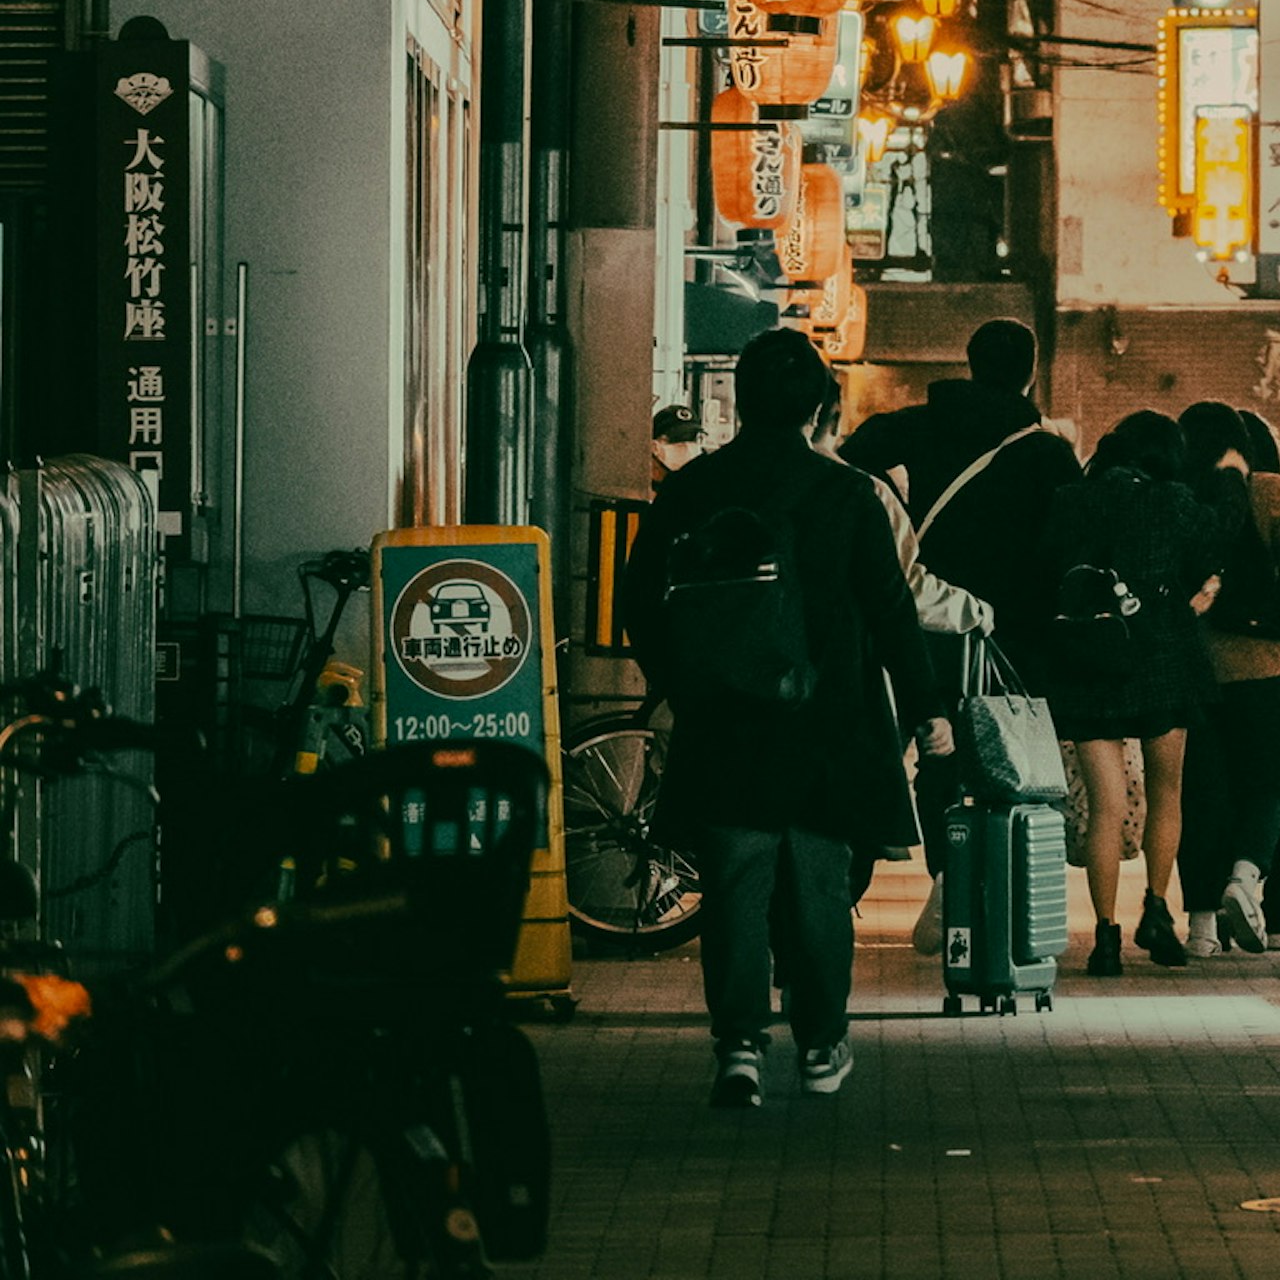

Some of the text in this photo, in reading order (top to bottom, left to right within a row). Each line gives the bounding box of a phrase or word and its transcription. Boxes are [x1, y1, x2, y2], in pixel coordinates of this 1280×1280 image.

[123, 127, 166, 342] 大阪松竹座
[402, 635, 523, 660] 車両通行止め
